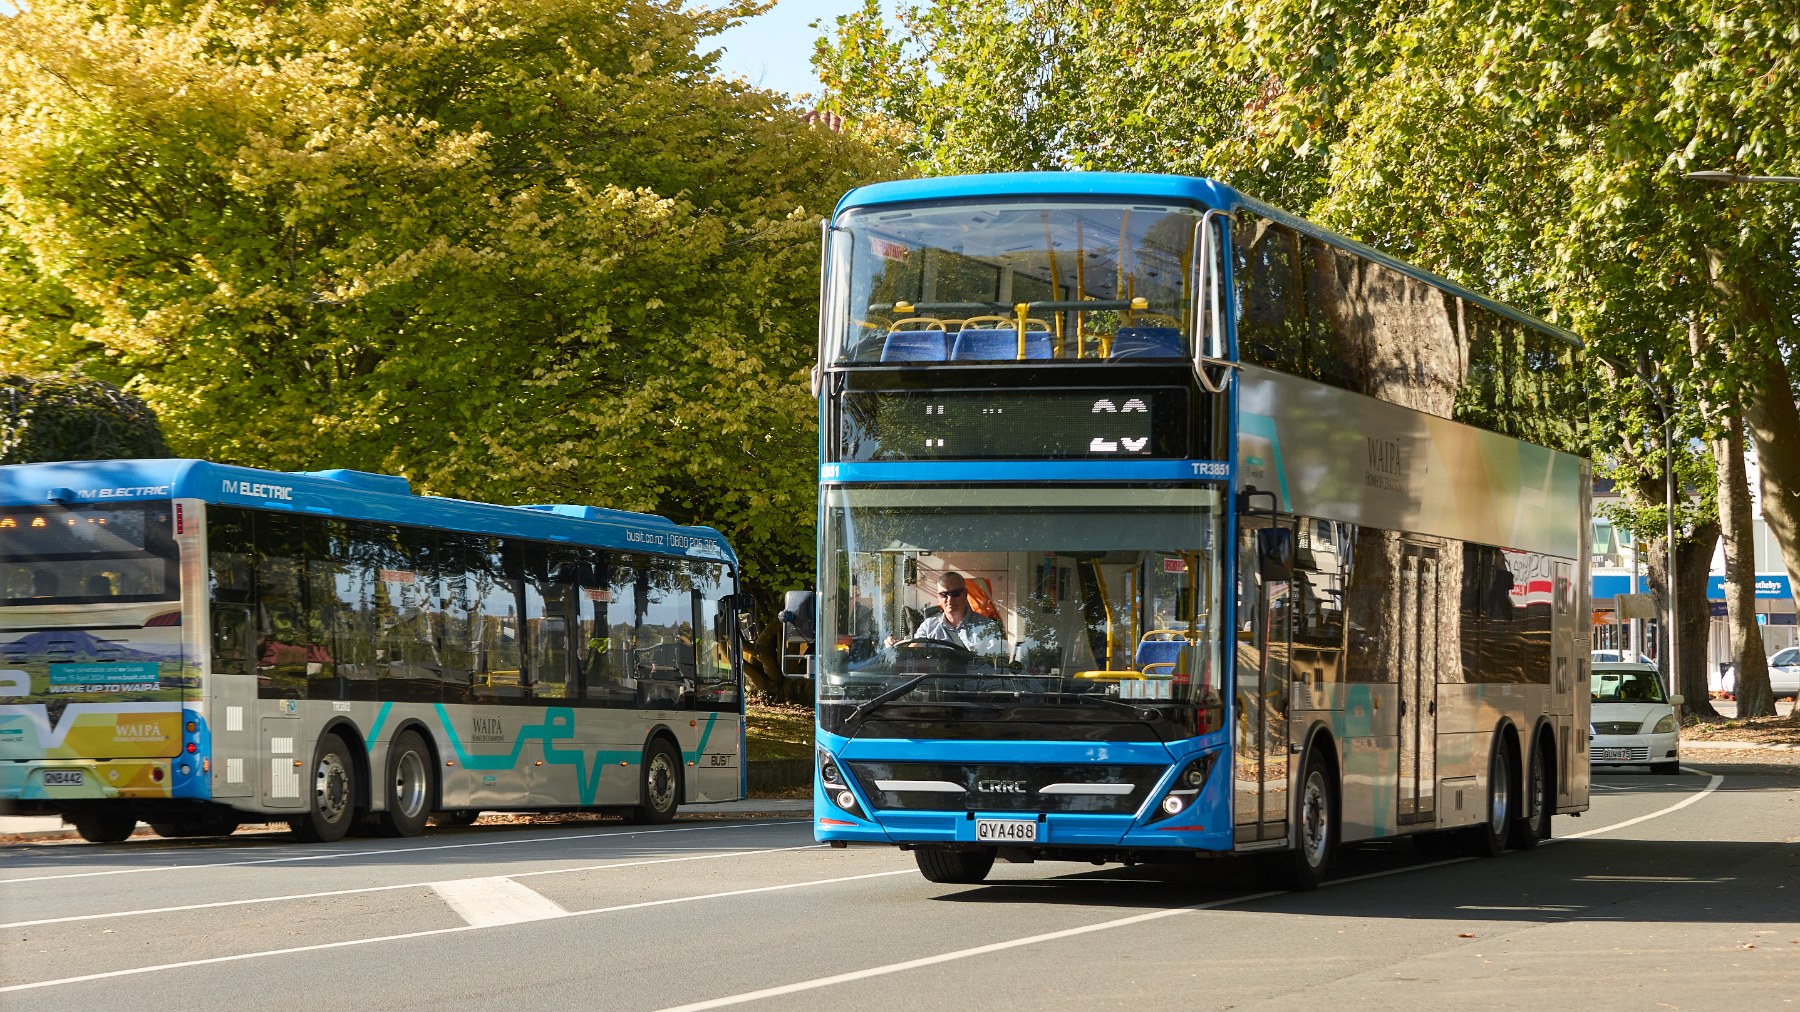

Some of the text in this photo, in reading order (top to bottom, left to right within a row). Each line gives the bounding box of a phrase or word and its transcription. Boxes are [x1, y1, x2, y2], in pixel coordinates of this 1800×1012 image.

[1191, 463, 1230, 475] TR3851
[98, 485, 170, 498] ELECTRIC
[239, 481, 293, 501] ELECTRIC
[626, 529, 664, 546] busit.co.nz
[670, 534, 689, 549] 0800
[1754, 580, 1782, 590] otheby's
[50, 684, 85, 693] WAKE
[86, 684, 104, 692] UP
[104, 684, 121, 692] TO
[115, 722, 161, 737] WAIPĀ
[473, 716, 502, 734] WAIPĀ
[45, 771, 83, 784] QNB442
[978, 779, 1027, 794] CRRC
[978, 824, 1034, 839] QYA488
